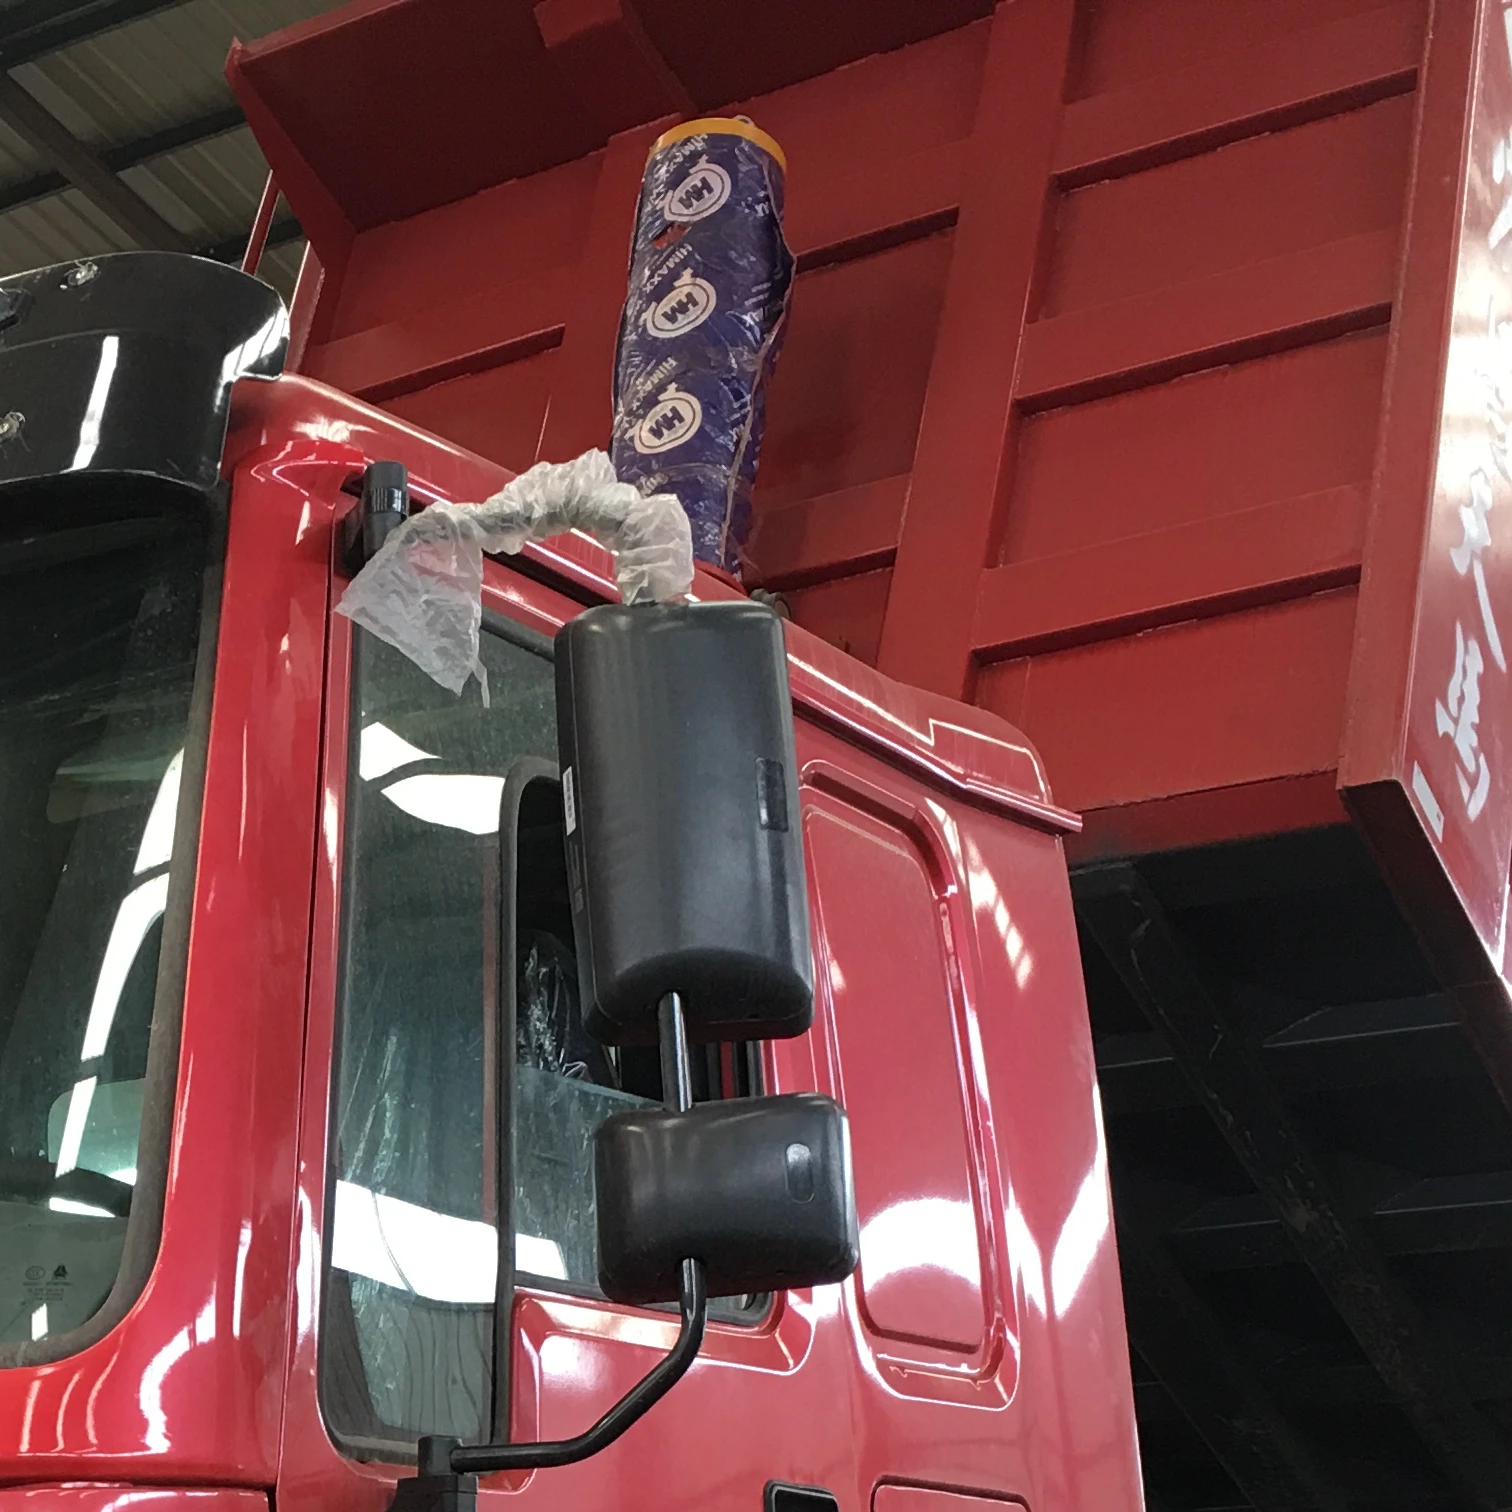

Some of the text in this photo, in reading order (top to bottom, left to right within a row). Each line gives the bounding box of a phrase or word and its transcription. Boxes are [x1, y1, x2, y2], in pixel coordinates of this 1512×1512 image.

[677, 175, 714, 210] HM
[661, 291, 699, 324] HM
[648, 405, 685, 440] HM
